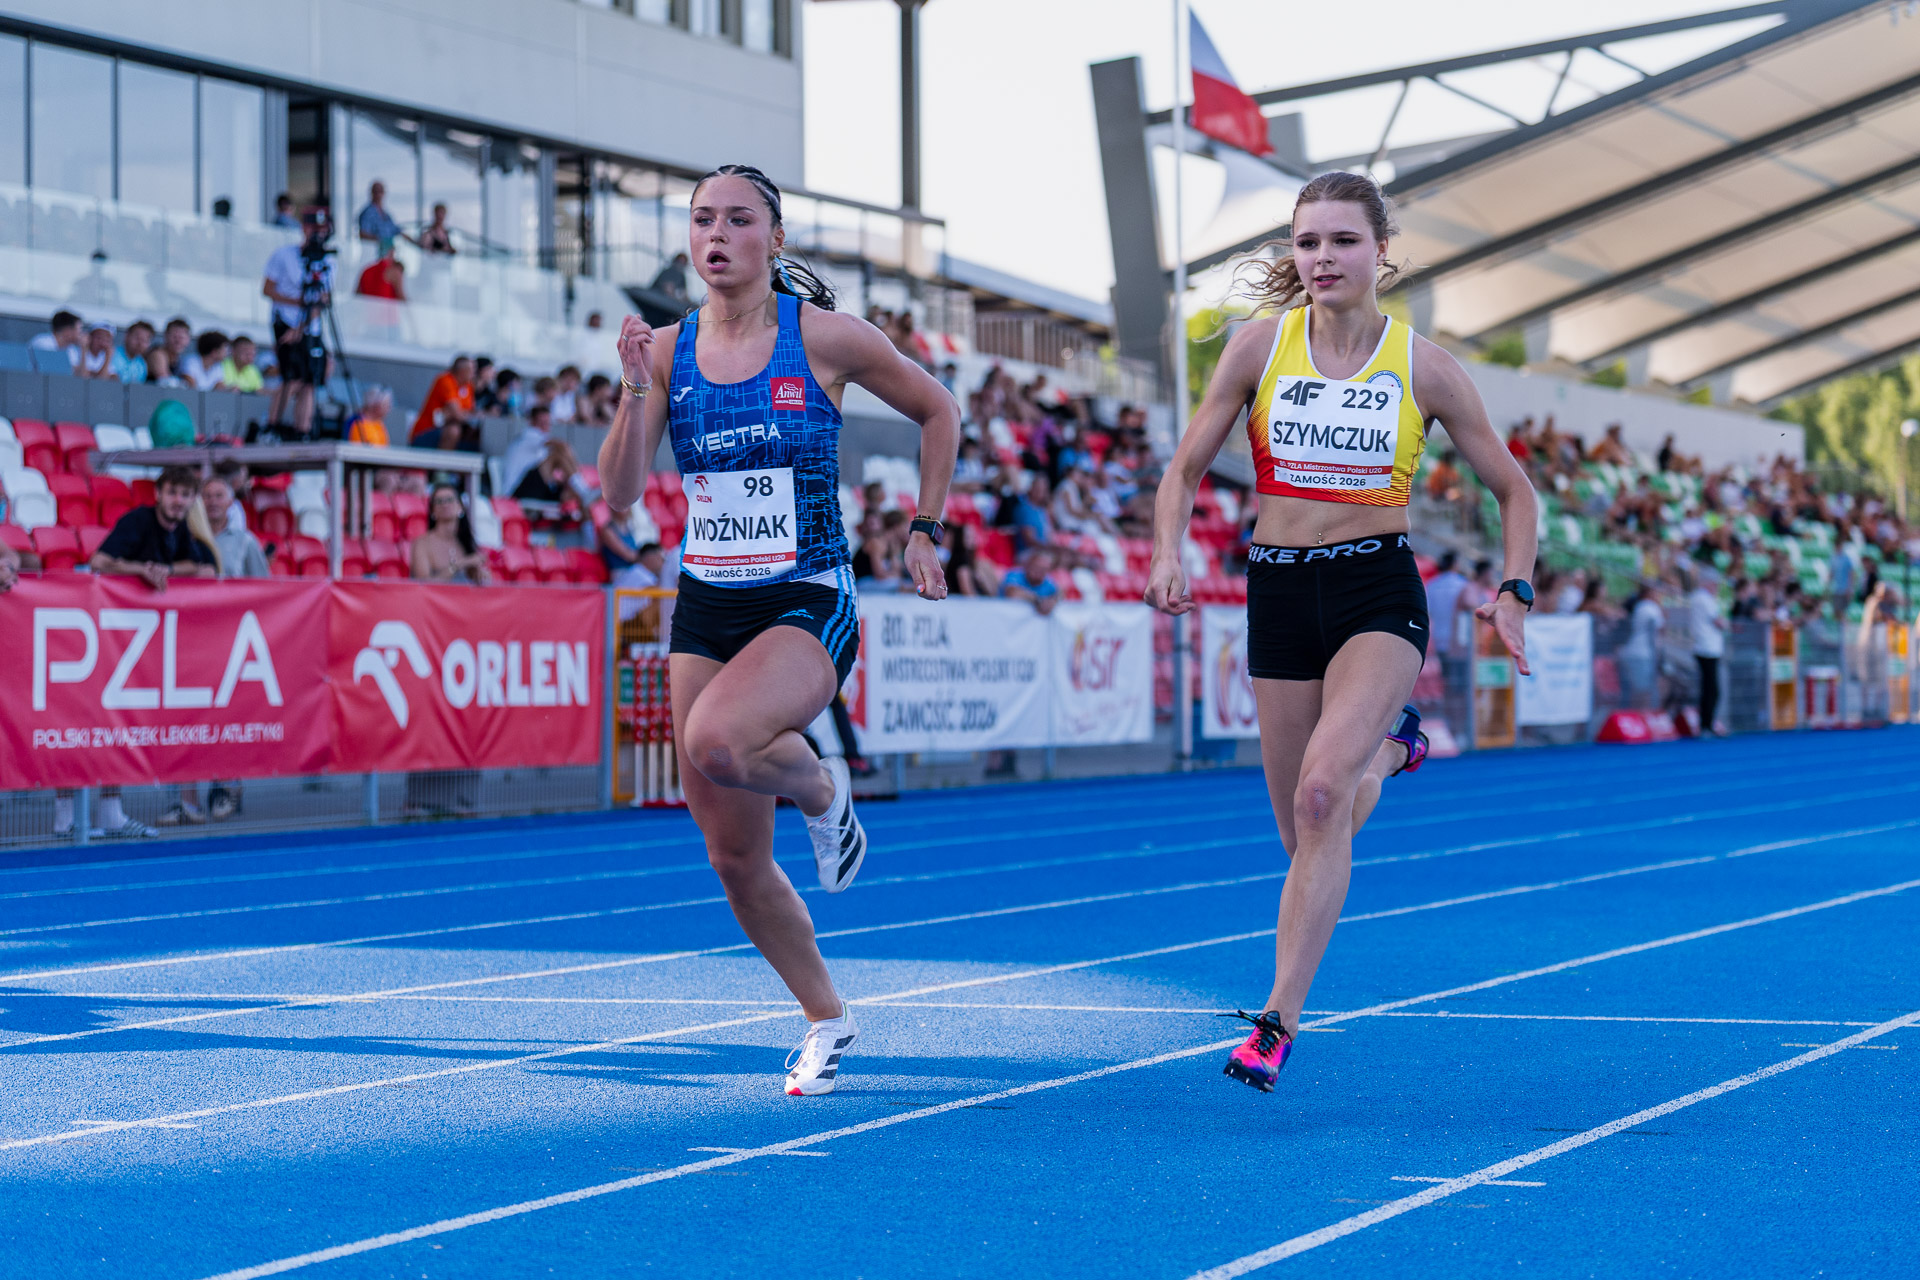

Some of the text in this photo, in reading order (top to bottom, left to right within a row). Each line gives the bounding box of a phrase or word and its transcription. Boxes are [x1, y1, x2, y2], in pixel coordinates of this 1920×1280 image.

[774, 385, 803, 399] Anwil
[1280, 380, 1326, 406] 4F
[1341, 388, 1390, 411] 229
[692, 422, 782, 453] VECTRA
[1273, 420, 1391, 453] SZYMCZUK
[1290, 474, 1366, 487] ZAMOŚĆ 2026
[1303, 463, 1345, 473] Mistrzostwa
[1347, 466, 1368, 474] Polski
[743, 475, 774, 497] 98
[693, 512, 789, 542] WOŹNIAK
[750, 555, 771, 563] Polski
[772, 554, 786, 562] U20
[1304, 539, 1382, 563] PRO
[704, 567, 771, 578] ZAMOŚĆ 2026
[32, 607, 284, 711] PZLA
[441, 638, 589, 709] ORLEN
[33, 728, 90, 750] POLSKI
[160, 724, 219, 746] LEKKIEJ
[220, 722, 284, 743] ATLETYKI
